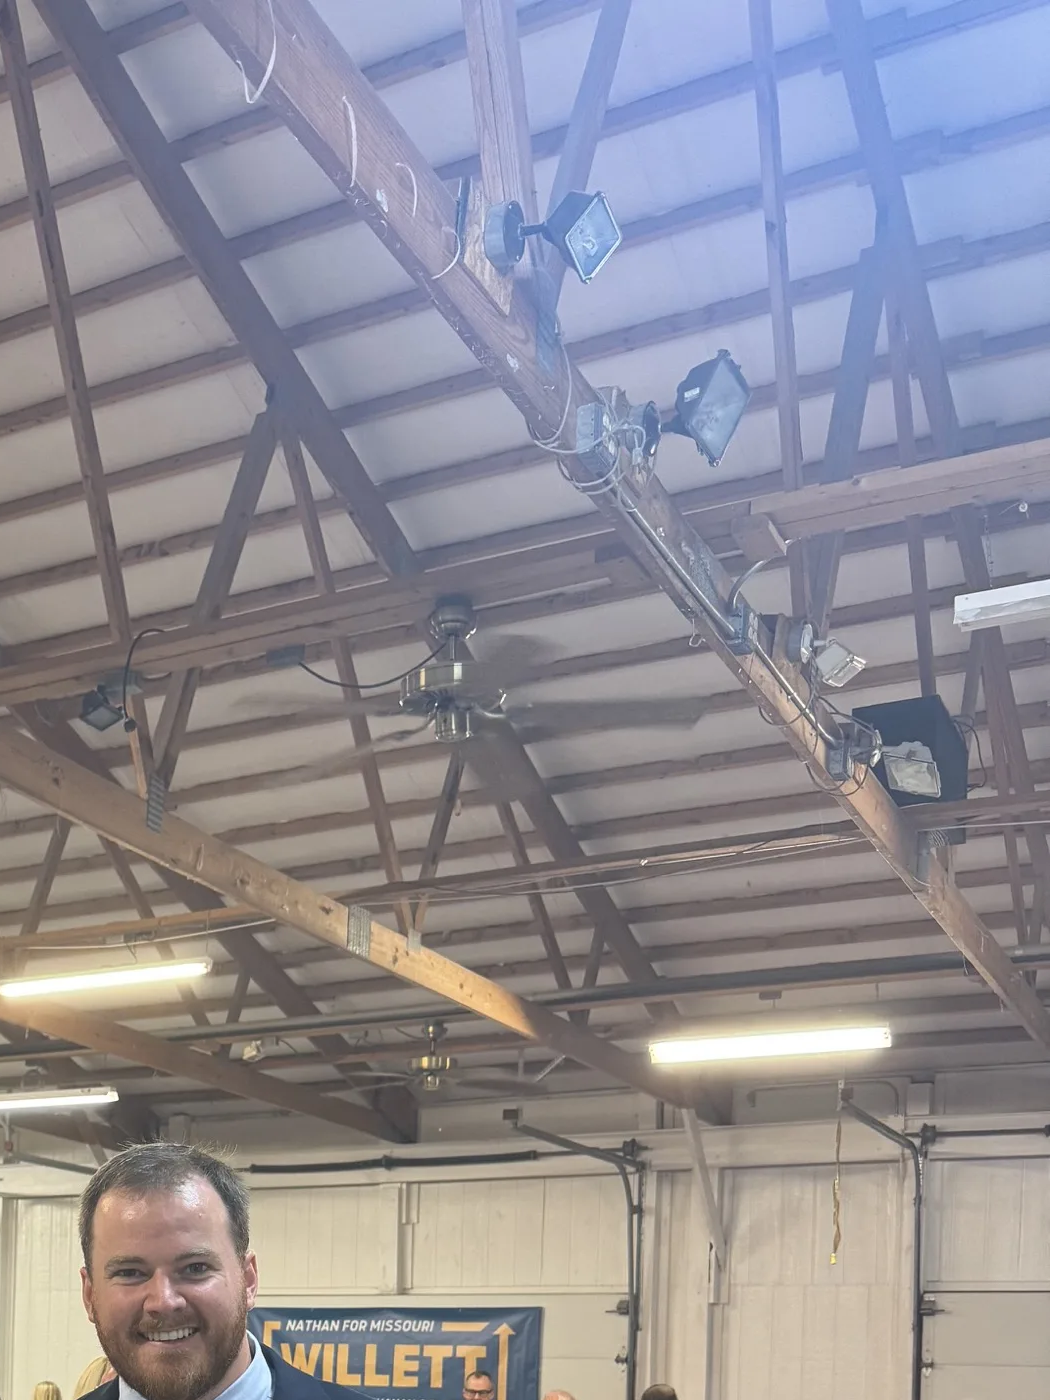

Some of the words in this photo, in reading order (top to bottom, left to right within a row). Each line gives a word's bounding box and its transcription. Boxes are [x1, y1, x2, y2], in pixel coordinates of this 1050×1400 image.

[285, 1319, 340, 1332] NATHAN
[341, 1320, 367, 1332] FOR
[369, 1320, 435, 1333] MISSOURI
[280, 1342, 487, 1388] WILLETT
